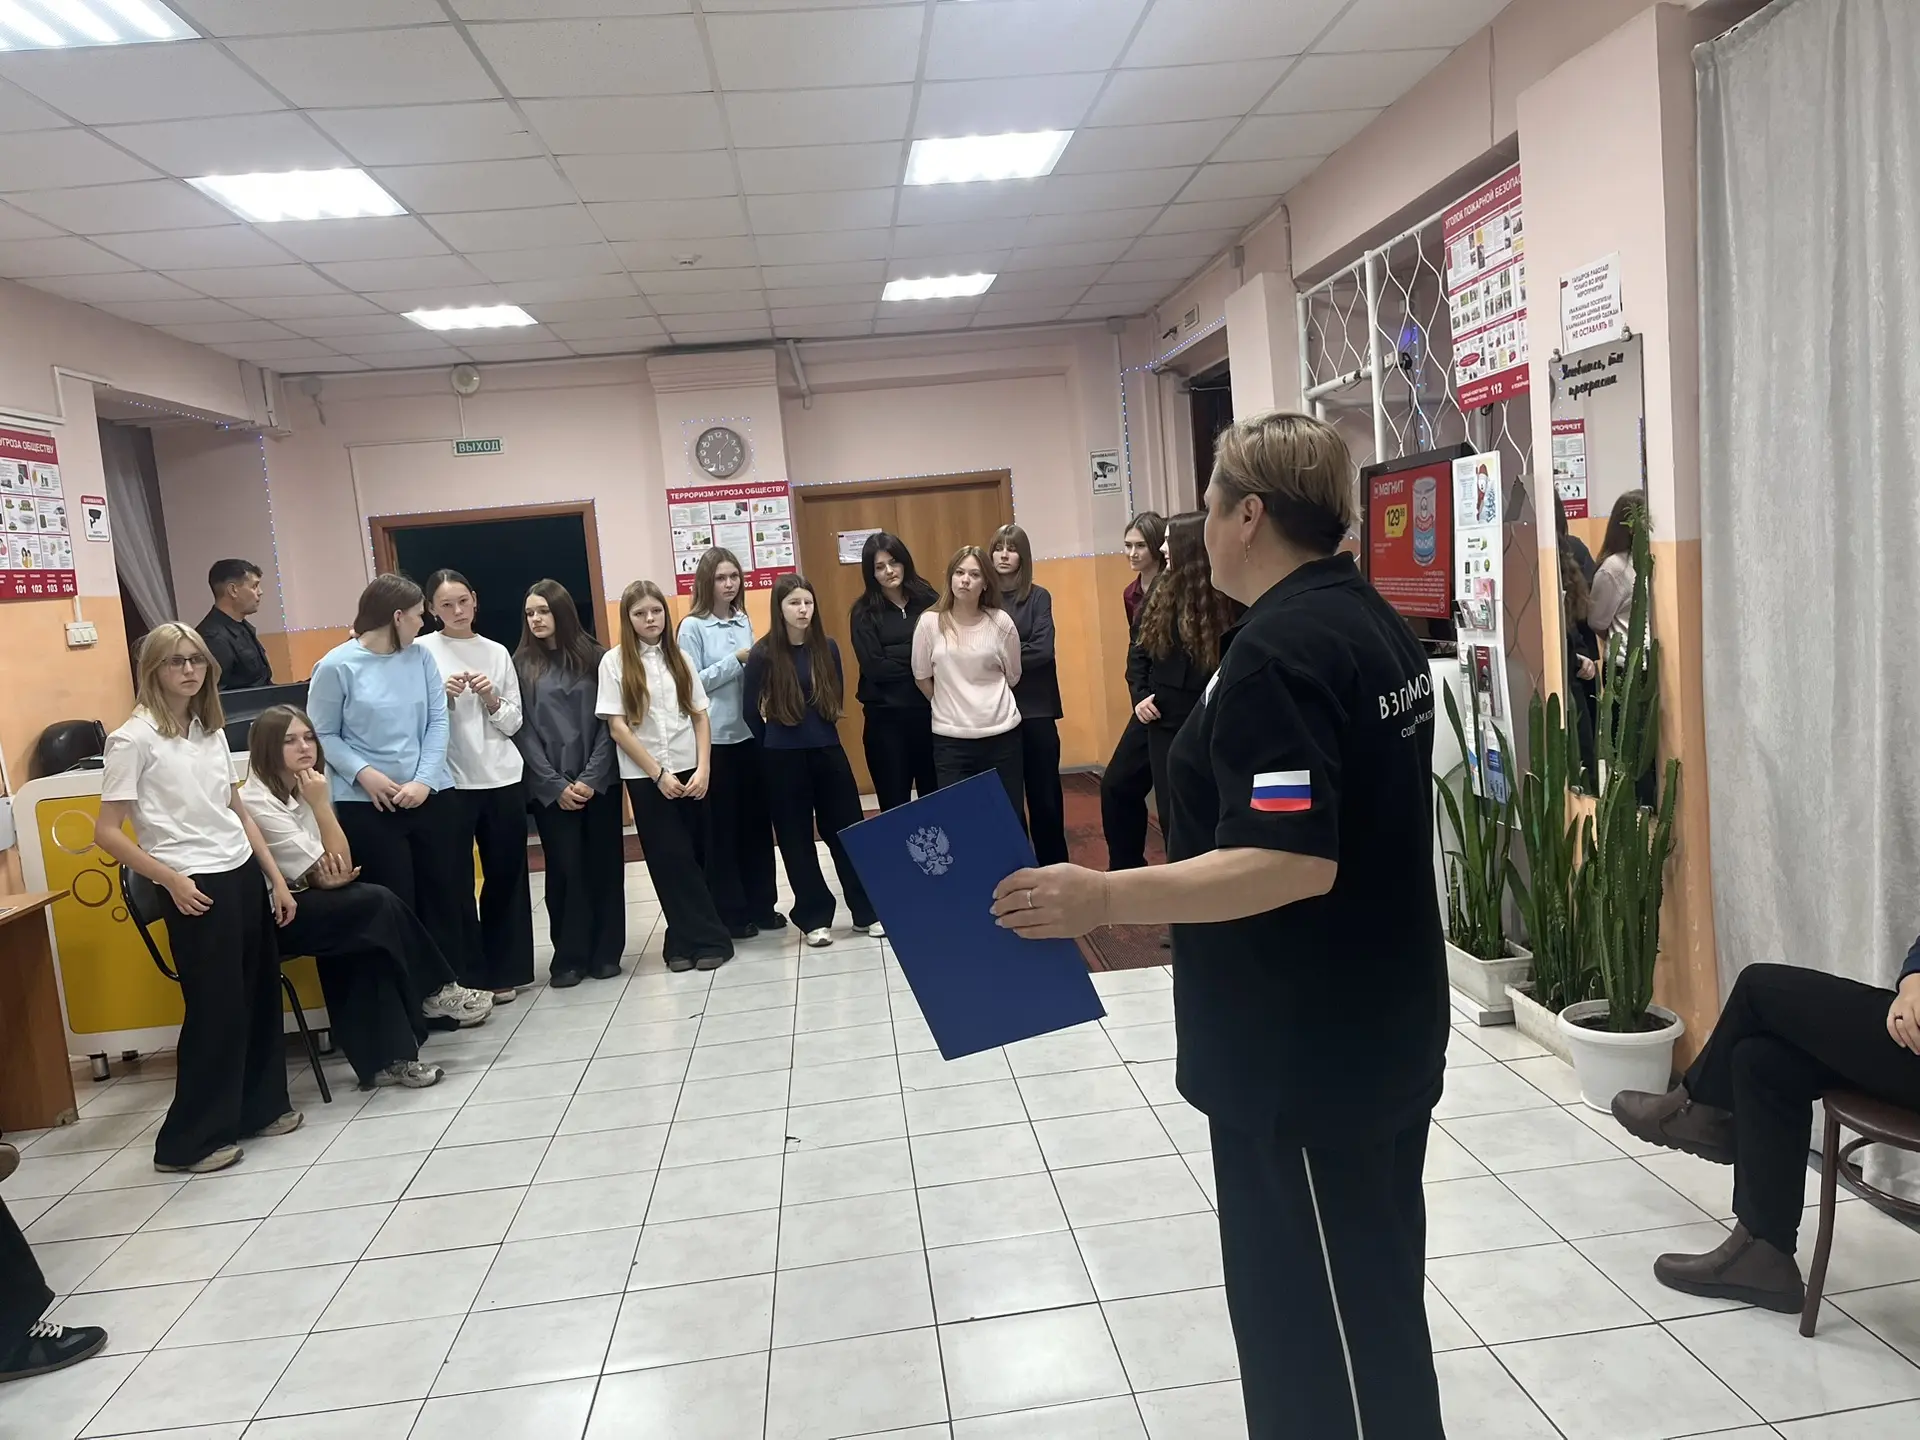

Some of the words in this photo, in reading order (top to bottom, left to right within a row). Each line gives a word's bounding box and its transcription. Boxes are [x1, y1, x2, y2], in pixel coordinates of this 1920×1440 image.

[1445, 215, 1464, 230] УГОЛОК
[1463, 190, 1494, 216] ПОЖАРНОЙ
[1579, 321, 1608, 338] ОСТАВЛЯТЬ
[1490, 382, 1503, 396] 112
[22, 441, 54, 454] ОБЩЕСТВУ
[459, 441, 500, 453] ВЫХОД
[670, 489, 743, 500] ТЕРРОРИЗМ-УГРОЗА
[744, 485, 785, 495] ОБЩЕСТВУ
[1387, 508, 1400, 528] 129
[15, 584, 26, 594] 101
[31, 584, 43, 593] 102
[47, 584, 58, 593] 103
[62, 583, 74, 593] 104
[759, 579, 773, 587] 103
